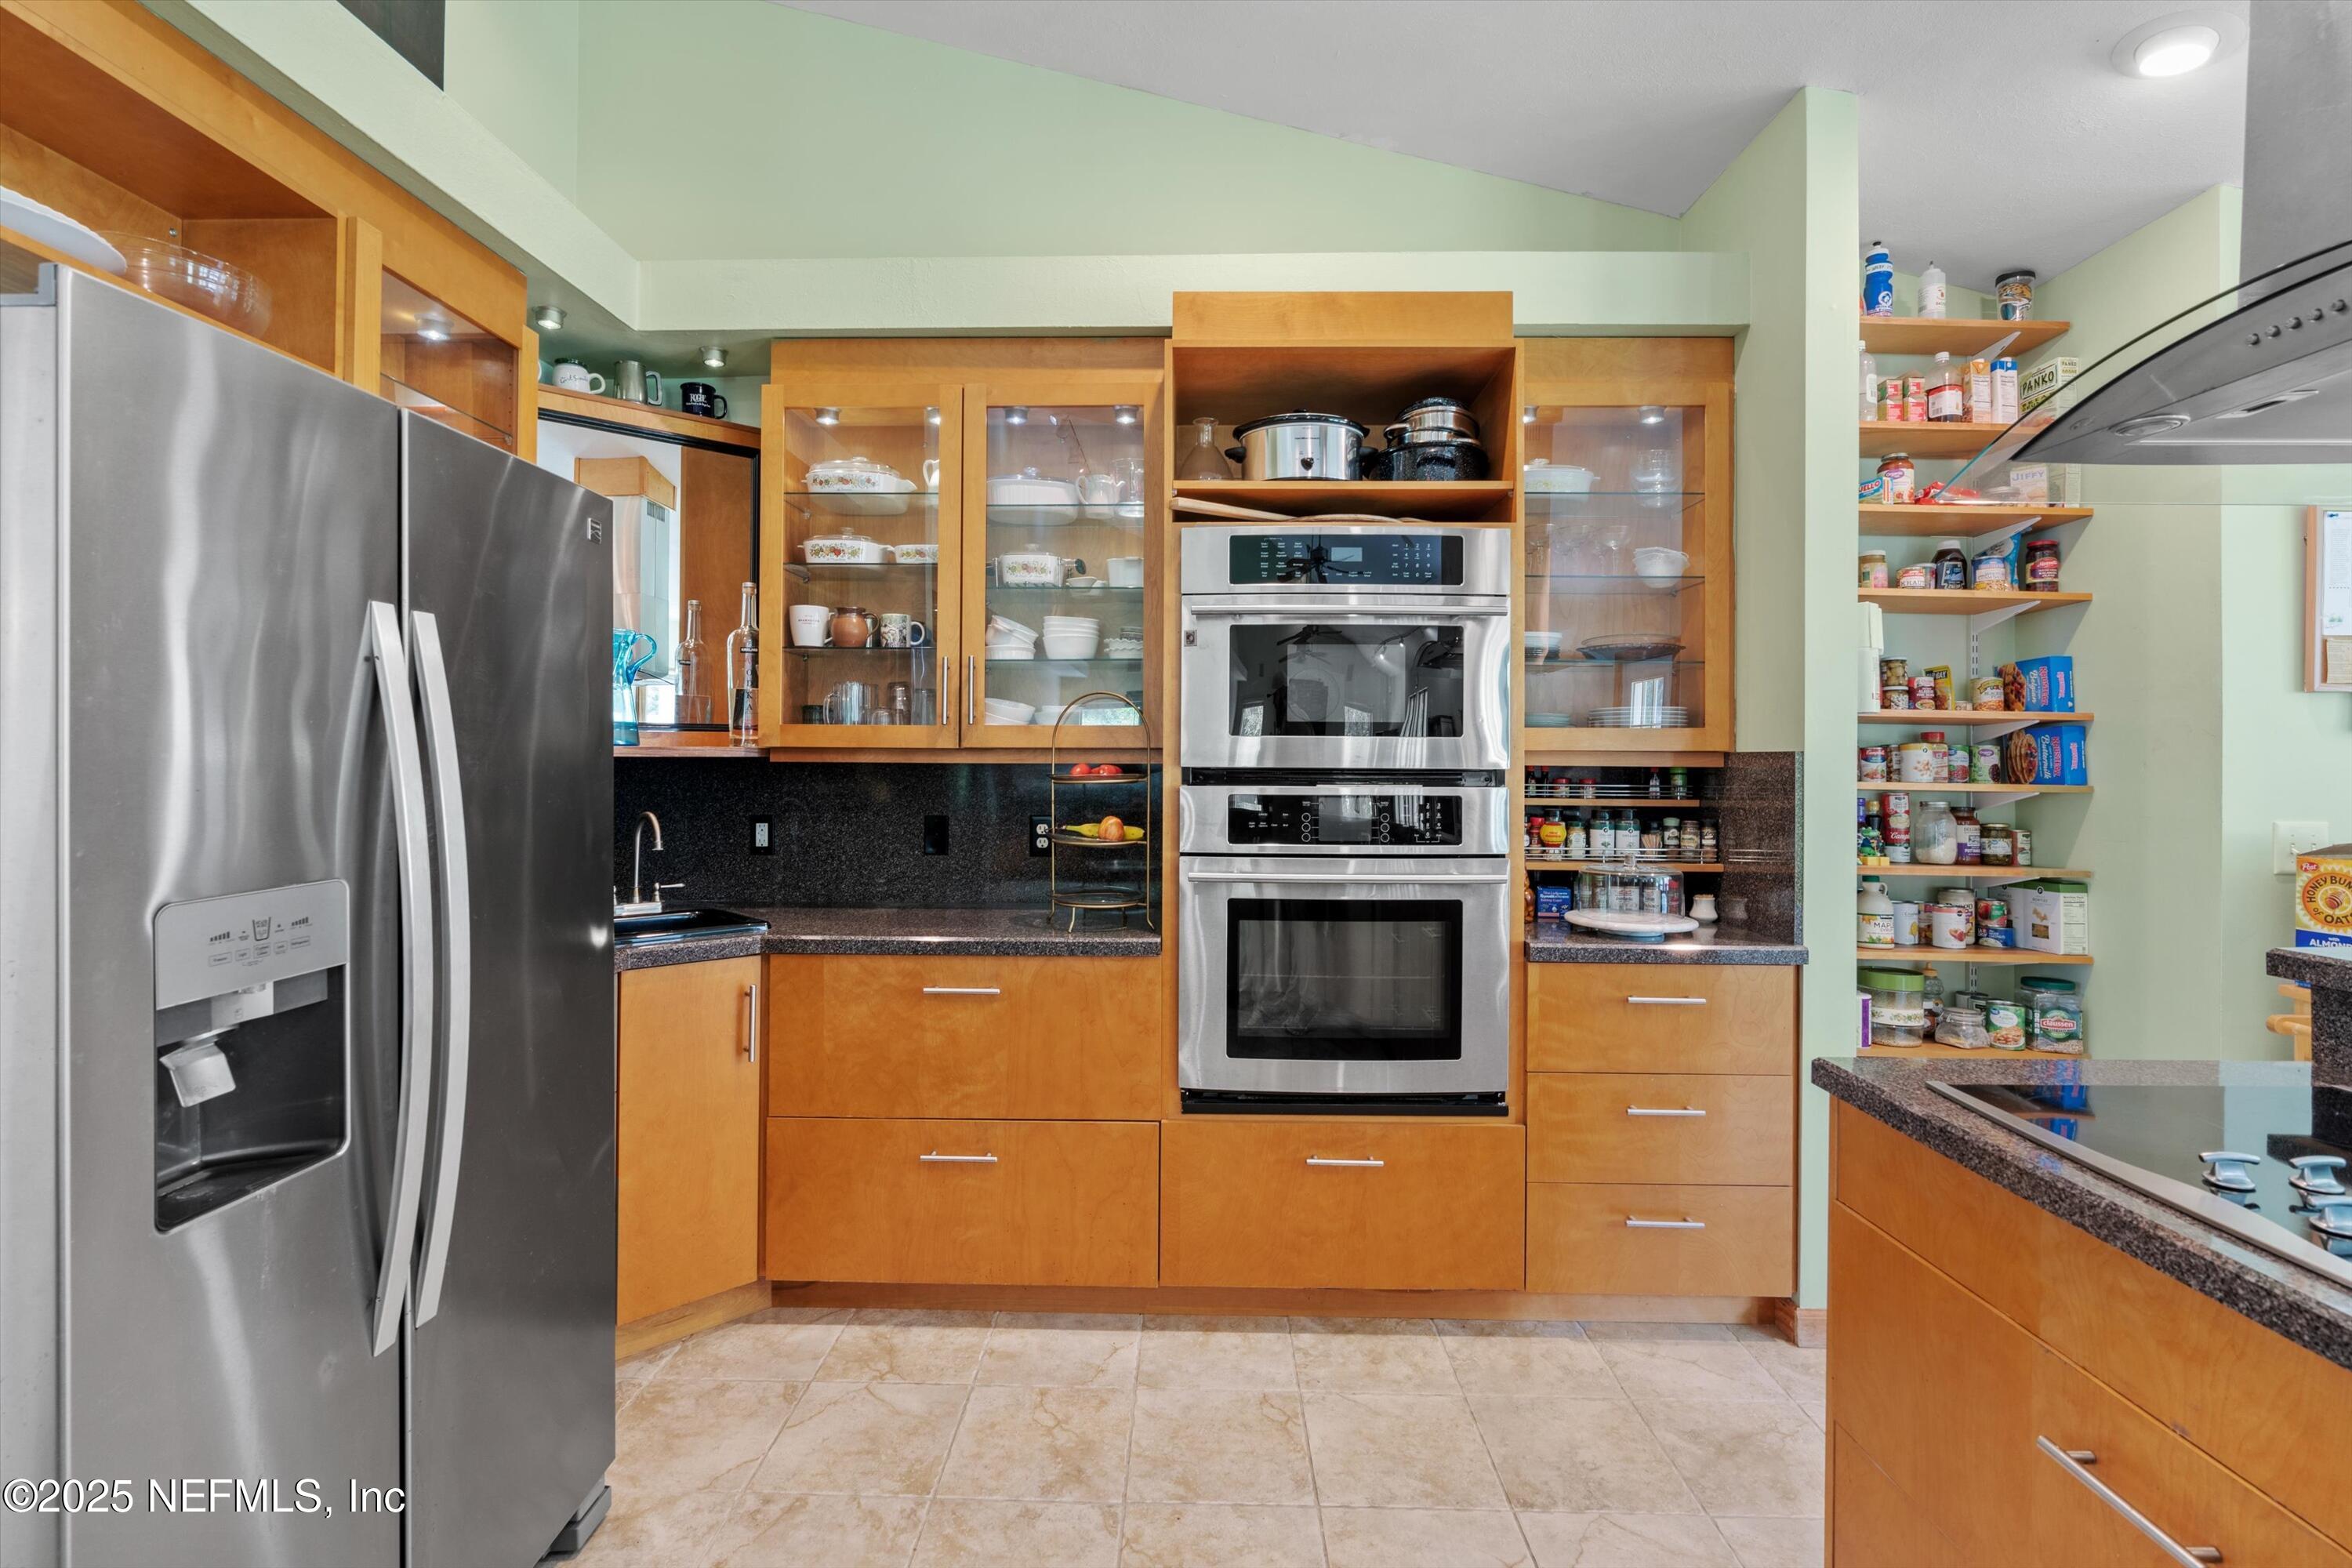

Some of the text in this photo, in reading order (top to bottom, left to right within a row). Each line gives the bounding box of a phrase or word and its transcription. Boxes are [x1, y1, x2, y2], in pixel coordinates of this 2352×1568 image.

[2022, 370, 2054, 395] PANKO
[2012, 470, 2045, 481] JIFFY
[2302, 862, 2318, 871] Post
[2307, 877, 2327, 902] HONEY
[2324, 912, 2352, 925] OAT
